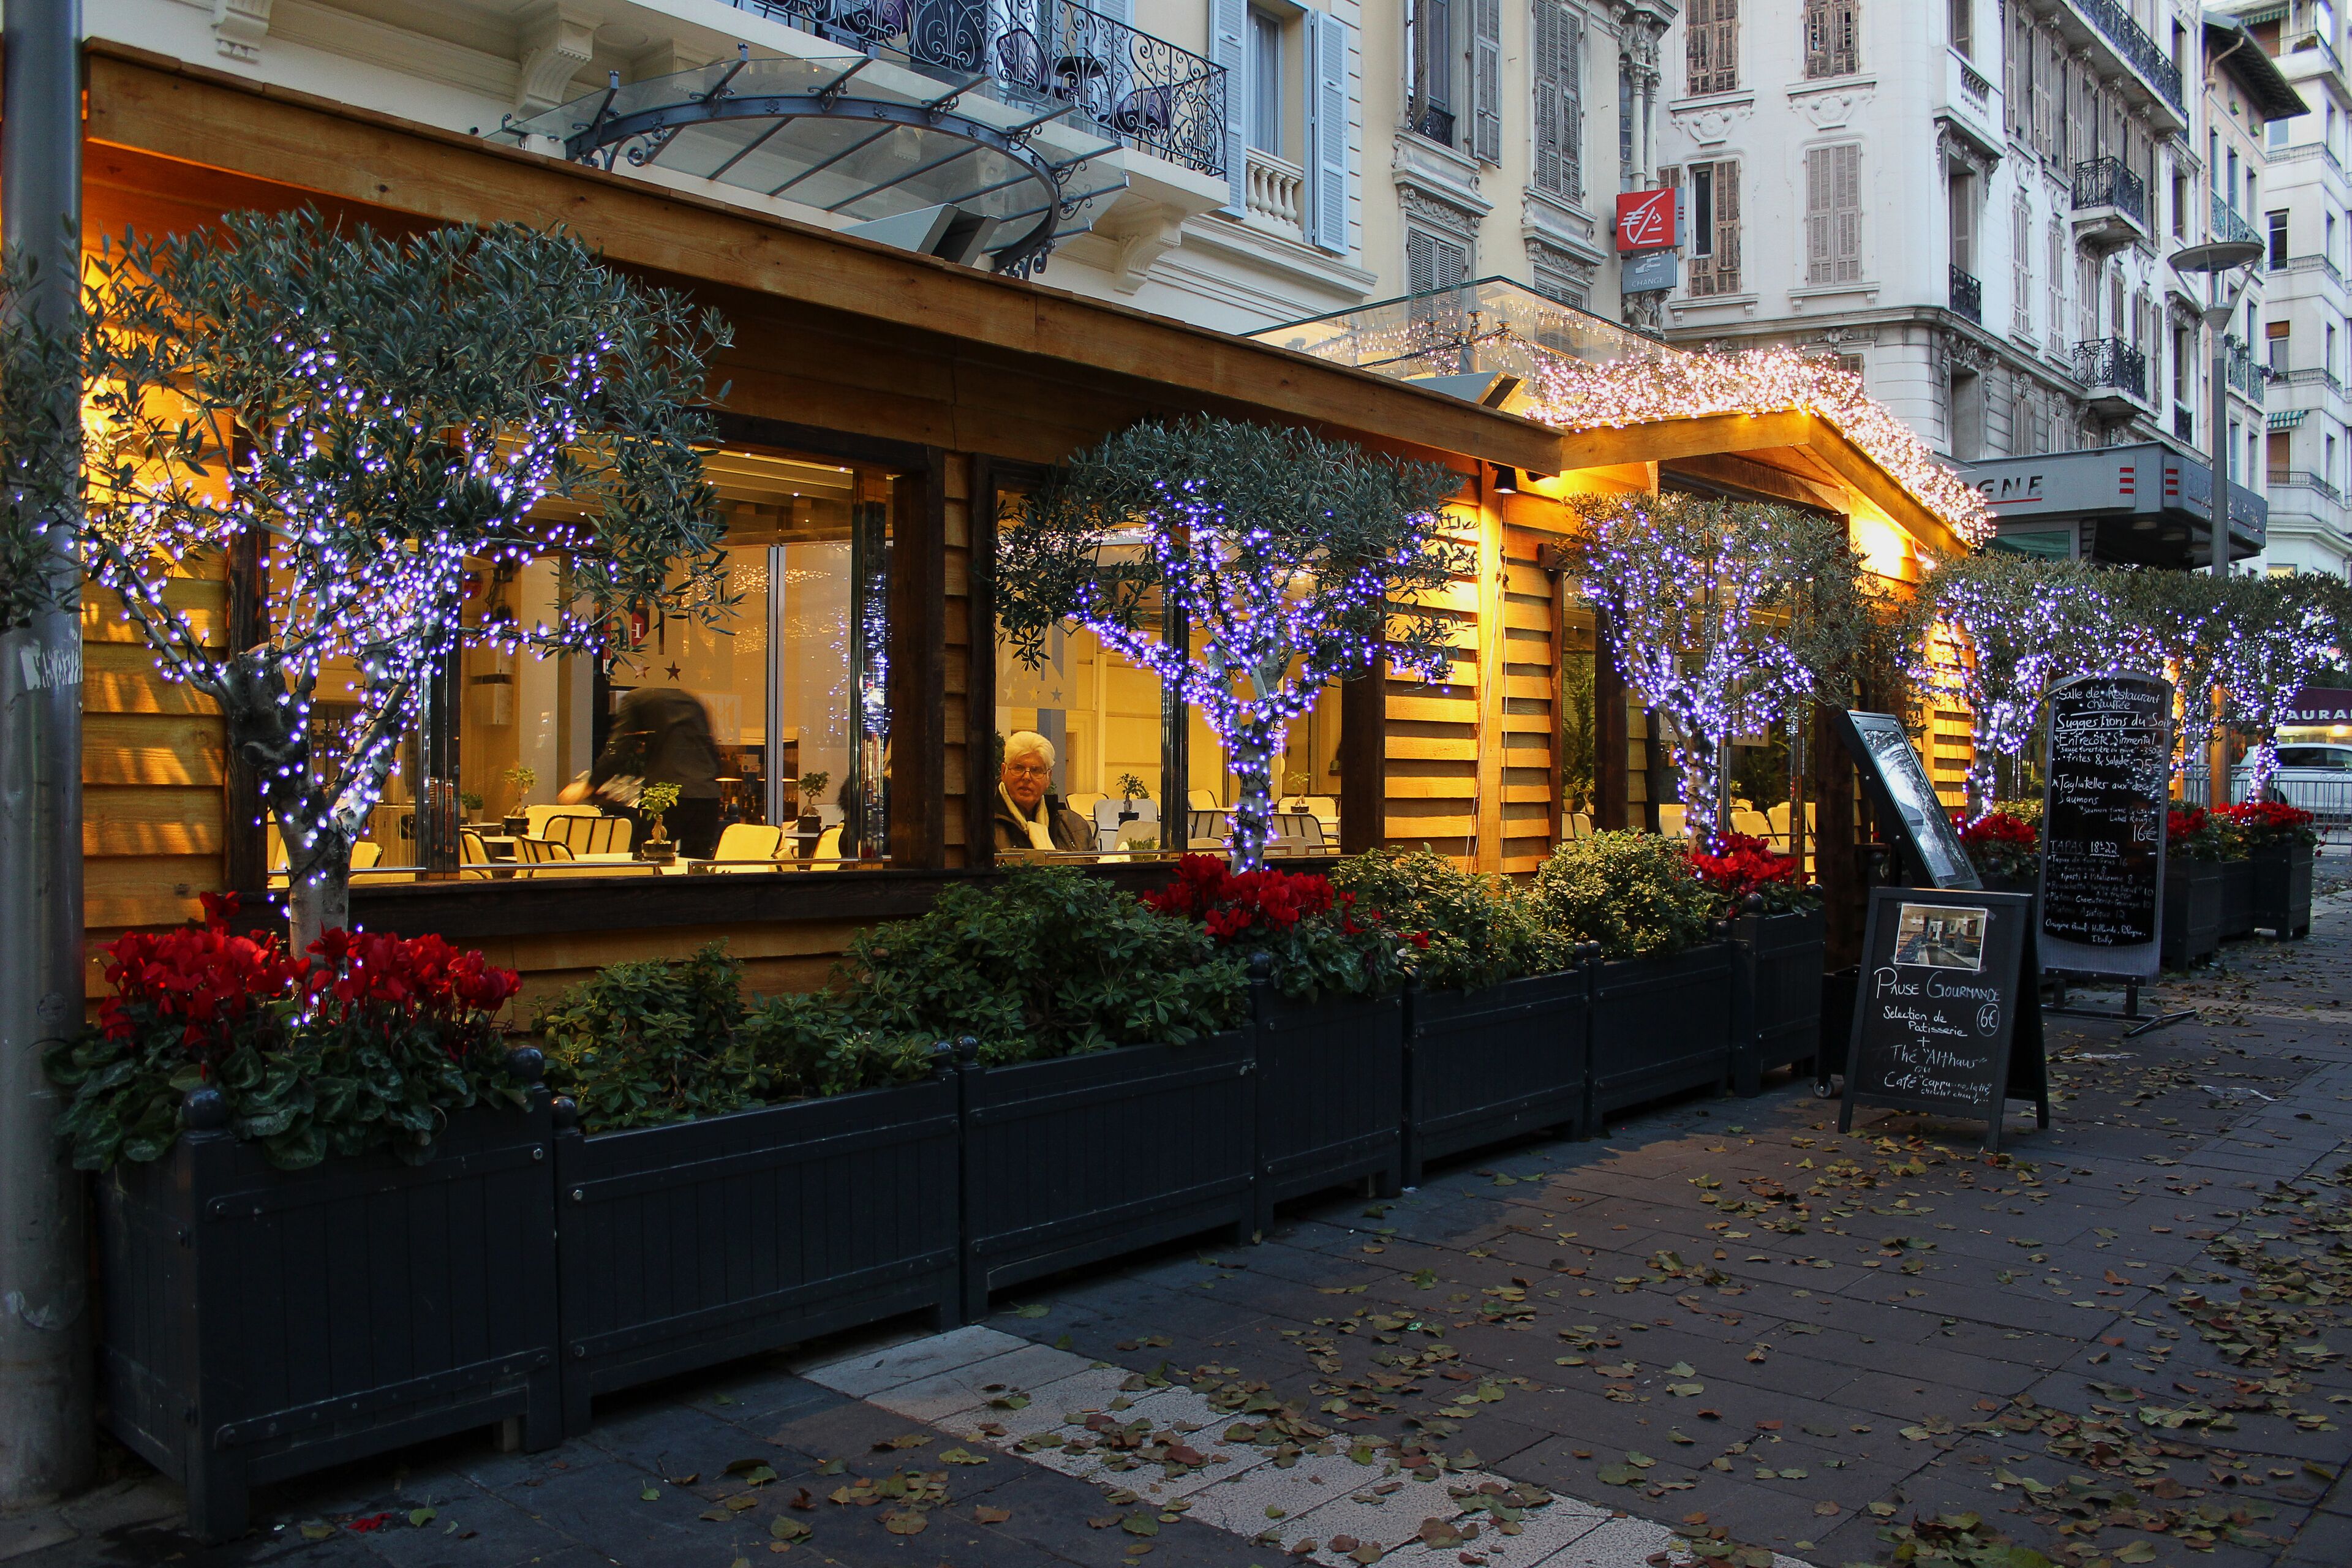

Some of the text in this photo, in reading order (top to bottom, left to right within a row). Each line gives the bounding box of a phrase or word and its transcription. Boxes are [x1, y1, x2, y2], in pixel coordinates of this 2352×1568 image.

[1632, 277, 1663, 287] CHANGE
[1964, 475, 2044, 501] GNE
[2059, 685, 2161, 704] Salle de Restaurant
[2087, 699, 2131, 710] chauffée
[2057, 712, 2173, 734] Suggestions du Soir
[2059, 731, 2157, 747] Entrecôte Simmental
[2095, 753, 2103, 766] &
[2112, 782, 2127, 790] aux
[2058, 790, 2099, 805] Saumons
[2133, 824, 2158, 842] 16€
[2050, 840, 2084, 854] TAPAS
[2127, 874, 2133, 885] 8
[2144, 886, 2154, 897] 10
[1883, 1005, 1997, 1028] Selection de 6€
[1908, 1020, 1968, 1037] Patisserie
[1890, 1044, 1918, 1064] Thé
[1884, 1071, 1917, 1090] Café
